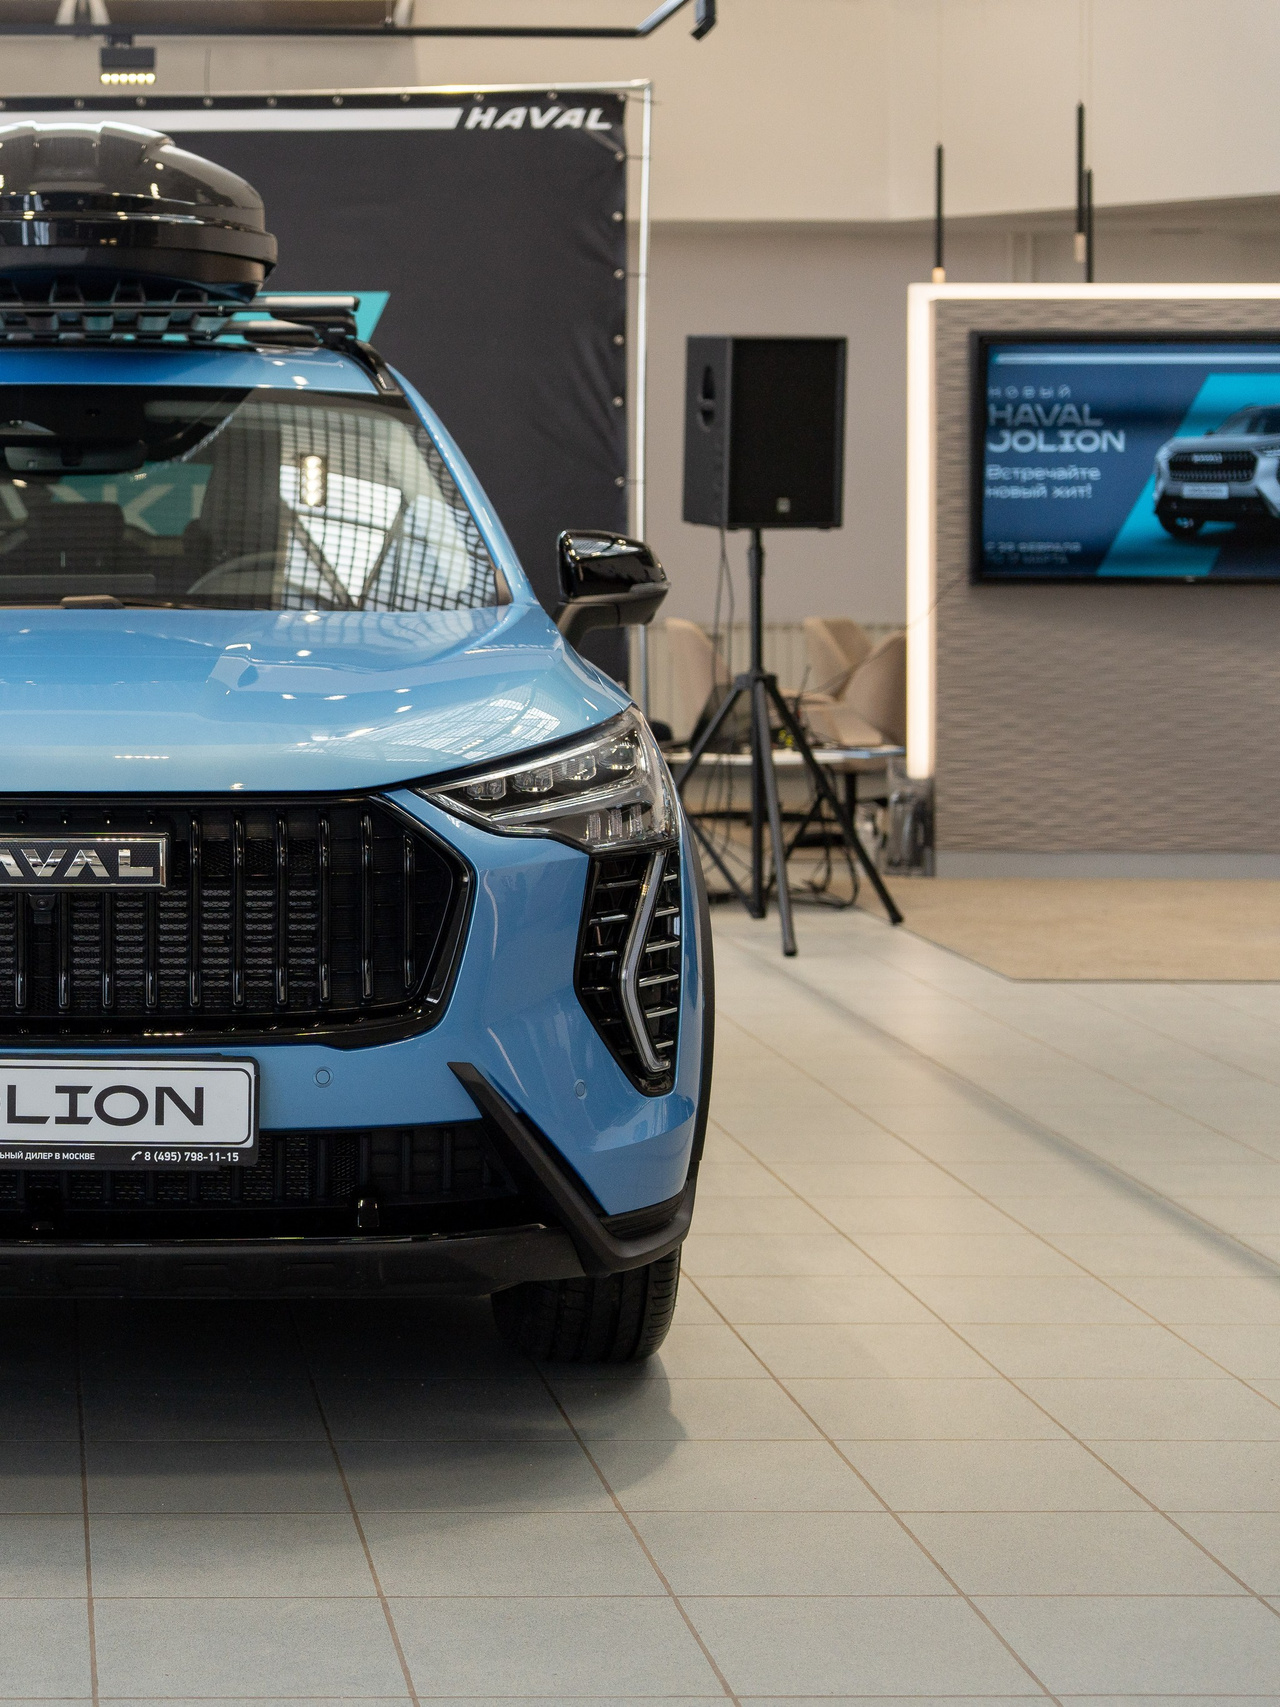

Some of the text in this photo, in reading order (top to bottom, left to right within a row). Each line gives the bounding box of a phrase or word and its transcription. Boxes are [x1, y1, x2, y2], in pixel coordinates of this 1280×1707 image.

[464, 105, 613, 131] HAVAL
[988, 402, 1104, 427] HAVAL
[986, 429, 1126, 453] JOLION
[985, 464, 1101, 482] Встречайте
[985, 483, 1048, 499] новый
[25, 1152, 53, 1160] ДИЛЕР
[144, 1151, 239, 1162] 8 (495) 798-11-15
